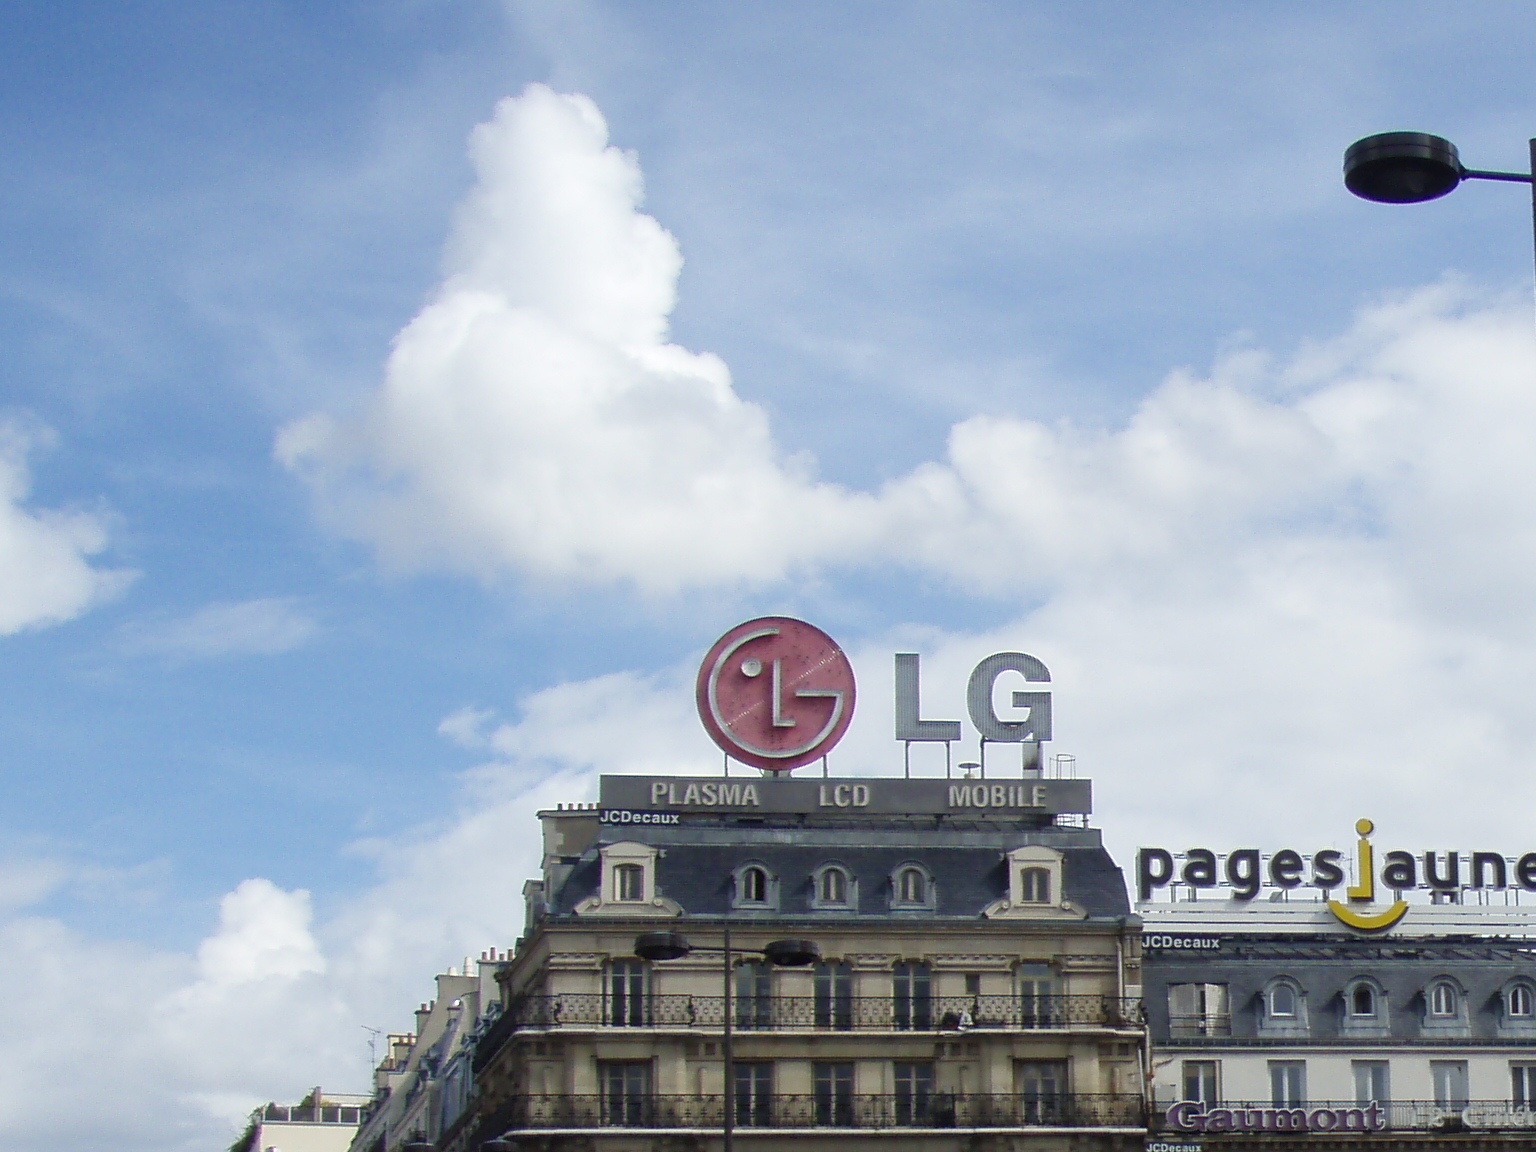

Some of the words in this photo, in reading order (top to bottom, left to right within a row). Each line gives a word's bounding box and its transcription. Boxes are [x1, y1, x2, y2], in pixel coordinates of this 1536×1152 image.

[895, 652, 1053, 742] LG
[651, 782, 760, 807] PLASMA
[819, 783, 870, 808] LCD
[948, 784, 1047, 809] MOBILE
[600, 810, 680, 826] JCDecaux
[1142, 935, 1220, 950] JCDecaux
[1165, 1099, 1386, 1132] Gaumont
[1146, 1142, 1203, 1152] JCDecaux
